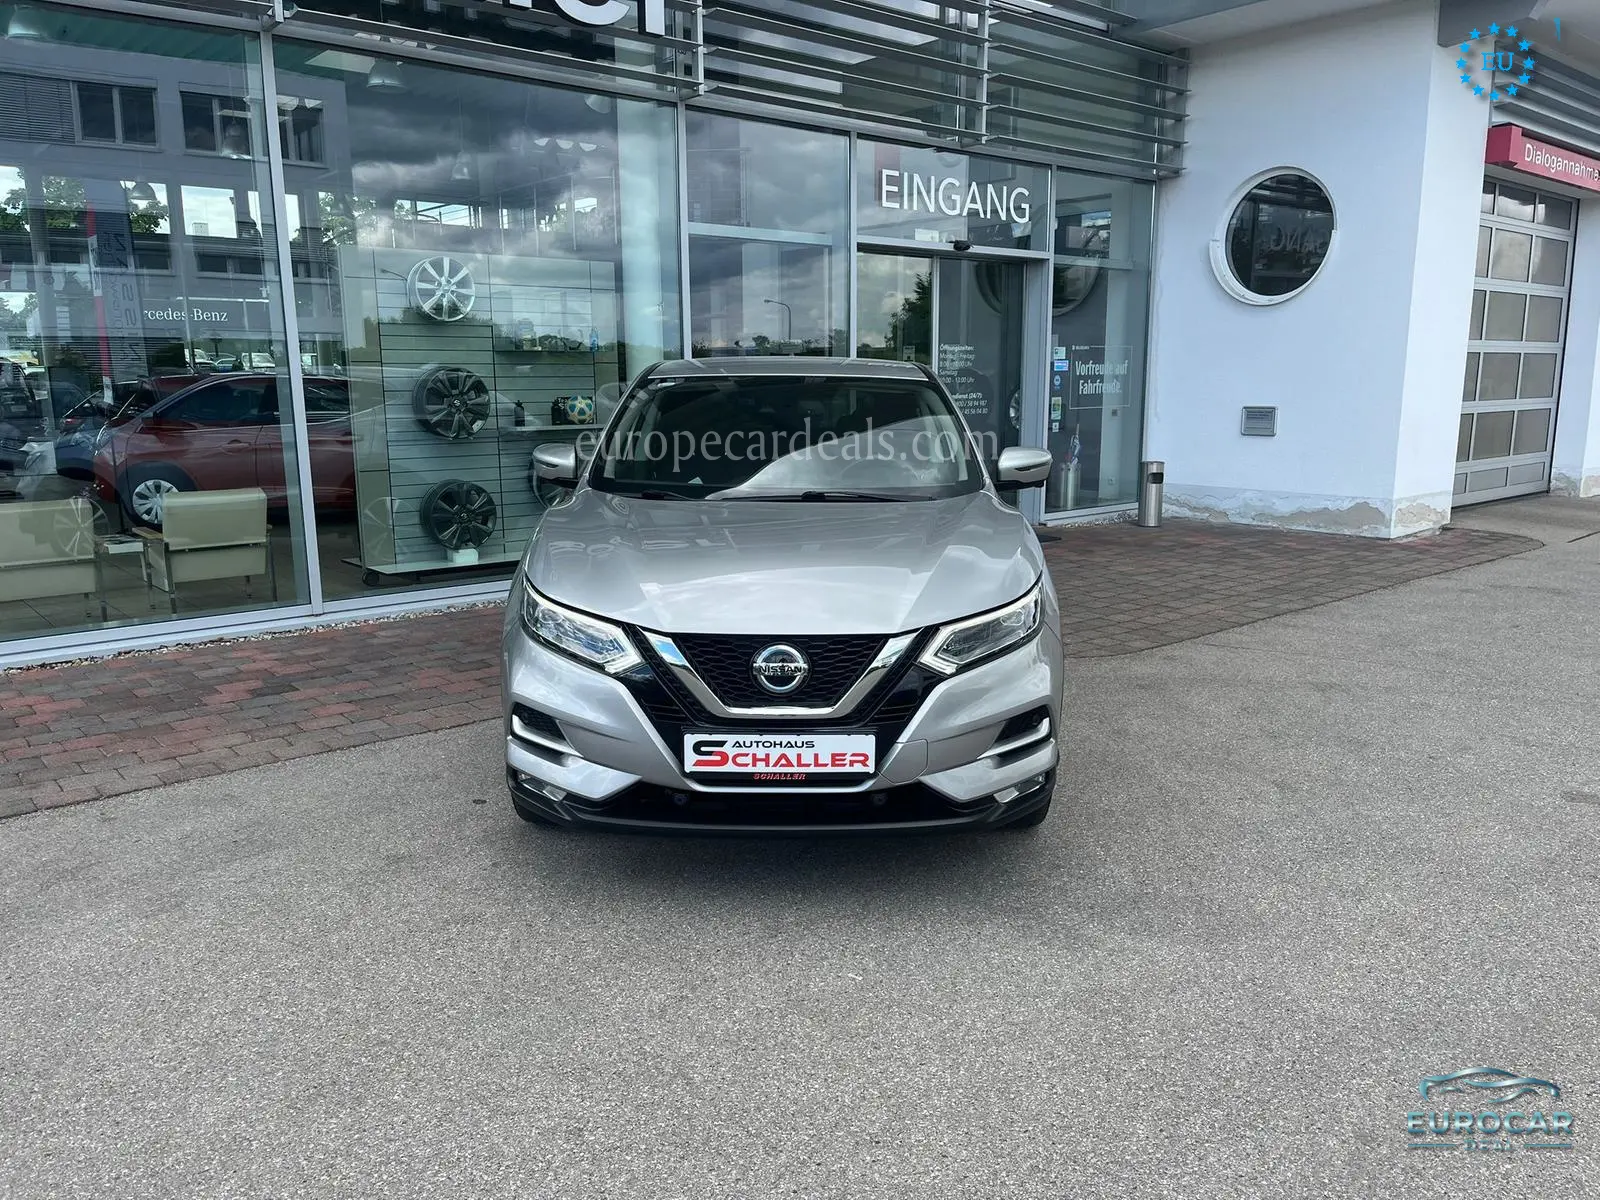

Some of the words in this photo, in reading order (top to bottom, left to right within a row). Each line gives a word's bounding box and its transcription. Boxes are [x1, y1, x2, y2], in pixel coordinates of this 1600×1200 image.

[881, 168, 1031, 224] EINGANG
[1075, 360, 1113, 376] Vorfreude
[1114, 360, 1129, 375] auf
[759, 664, 802, 673] NISSAN
[731, 740, 815, 749] AUTOHAUS
[692, 740, 870, 768] SCHALLER
